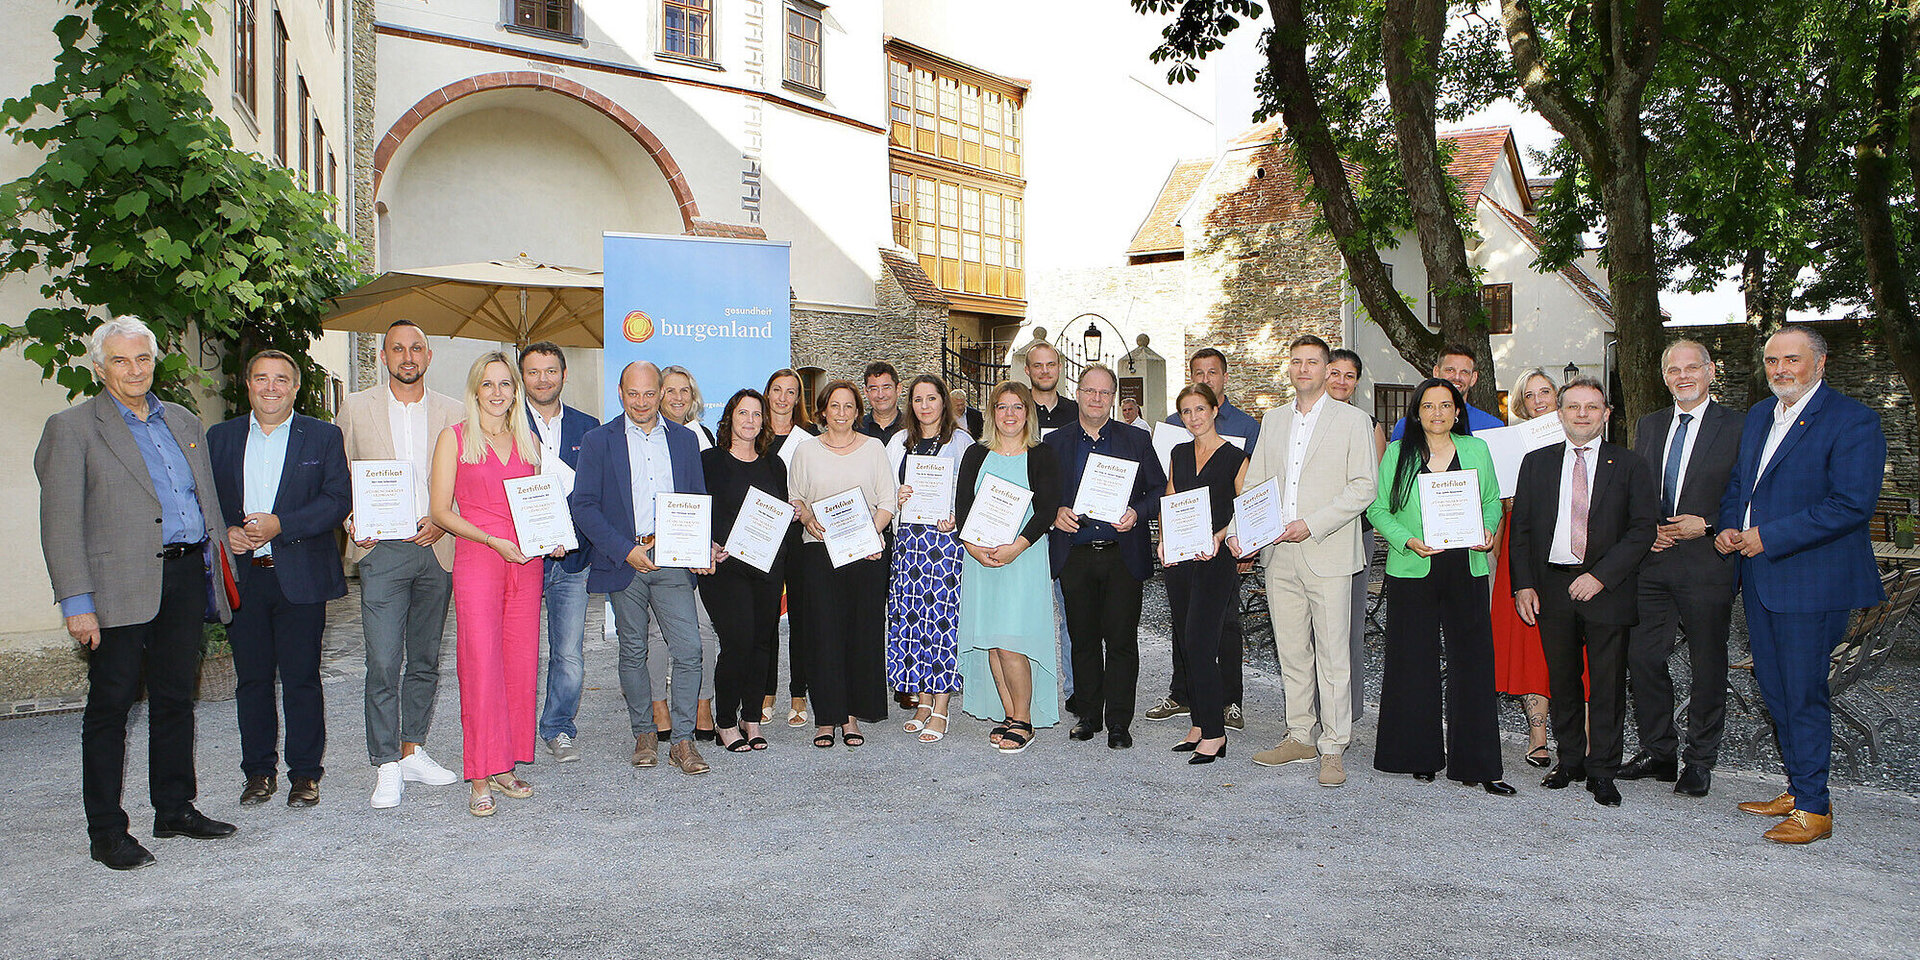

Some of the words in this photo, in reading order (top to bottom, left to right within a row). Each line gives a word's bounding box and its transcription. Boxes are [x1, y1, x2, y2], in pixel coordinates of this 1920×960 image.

[724, 306, 773, 317] gesundheit
[661, 318, 773, 342] burgenland
[1530, 420, 1562, 435] Zertifika
[915, 462, 945, 472] Zertifikat
[1096, 461, 1128, 474] Zertifikat
[365, 469, 403, 478] Zertifikat
[517, 483, 551, 494] Zertifikat
[1431, 480, 1467, 489] Zertifikat
[667, 500, 701, 510] Zertifikat
[754, 498, 784, 517] Zertifikat
